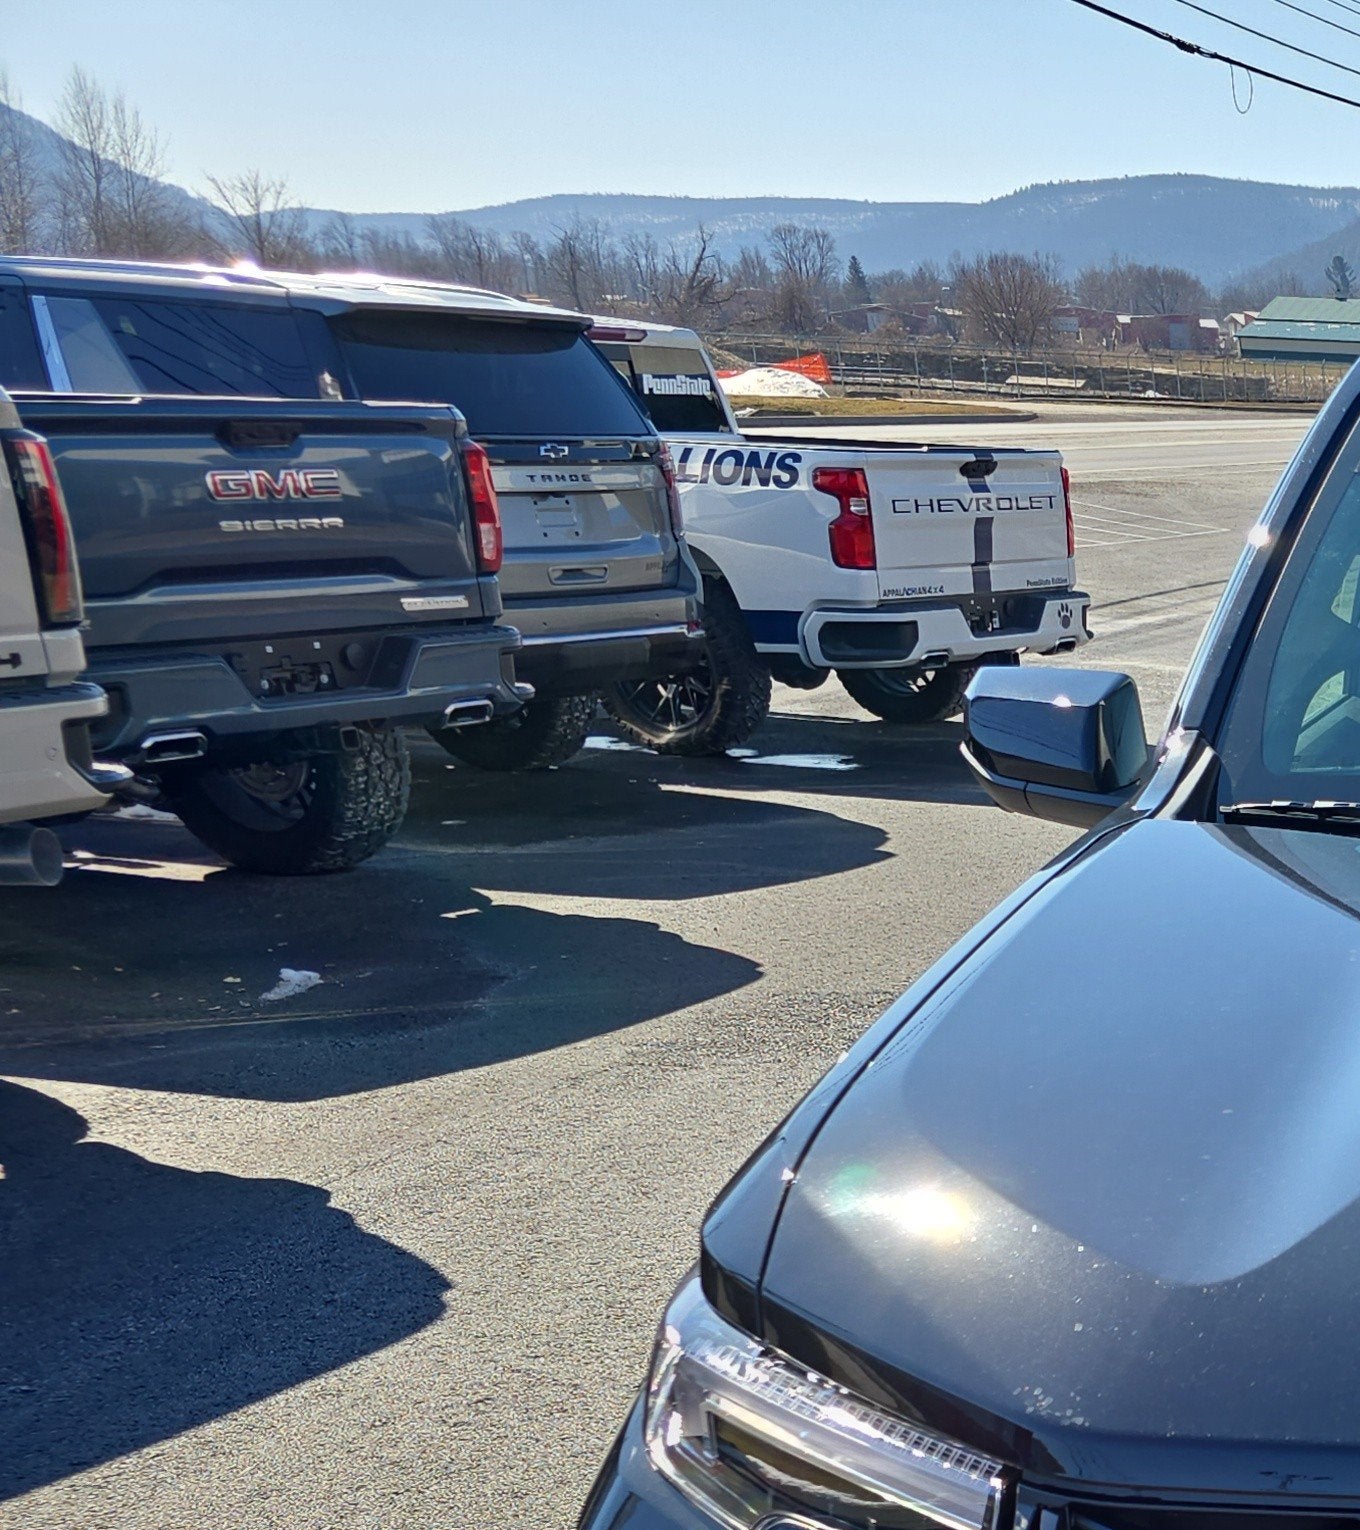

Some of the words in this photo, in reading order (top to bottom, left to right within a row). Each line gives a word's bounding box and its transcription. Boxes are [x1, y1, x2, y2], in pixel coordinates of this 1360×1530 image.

[676, 447, 803, 489] LIONS
[205, 468, 343, 501] GMC
[526, 474, 592, 483] TAHOE
[892, 495, 1057, 514] CHEVROLET
[219, 517, 344, 532] SIERRA
